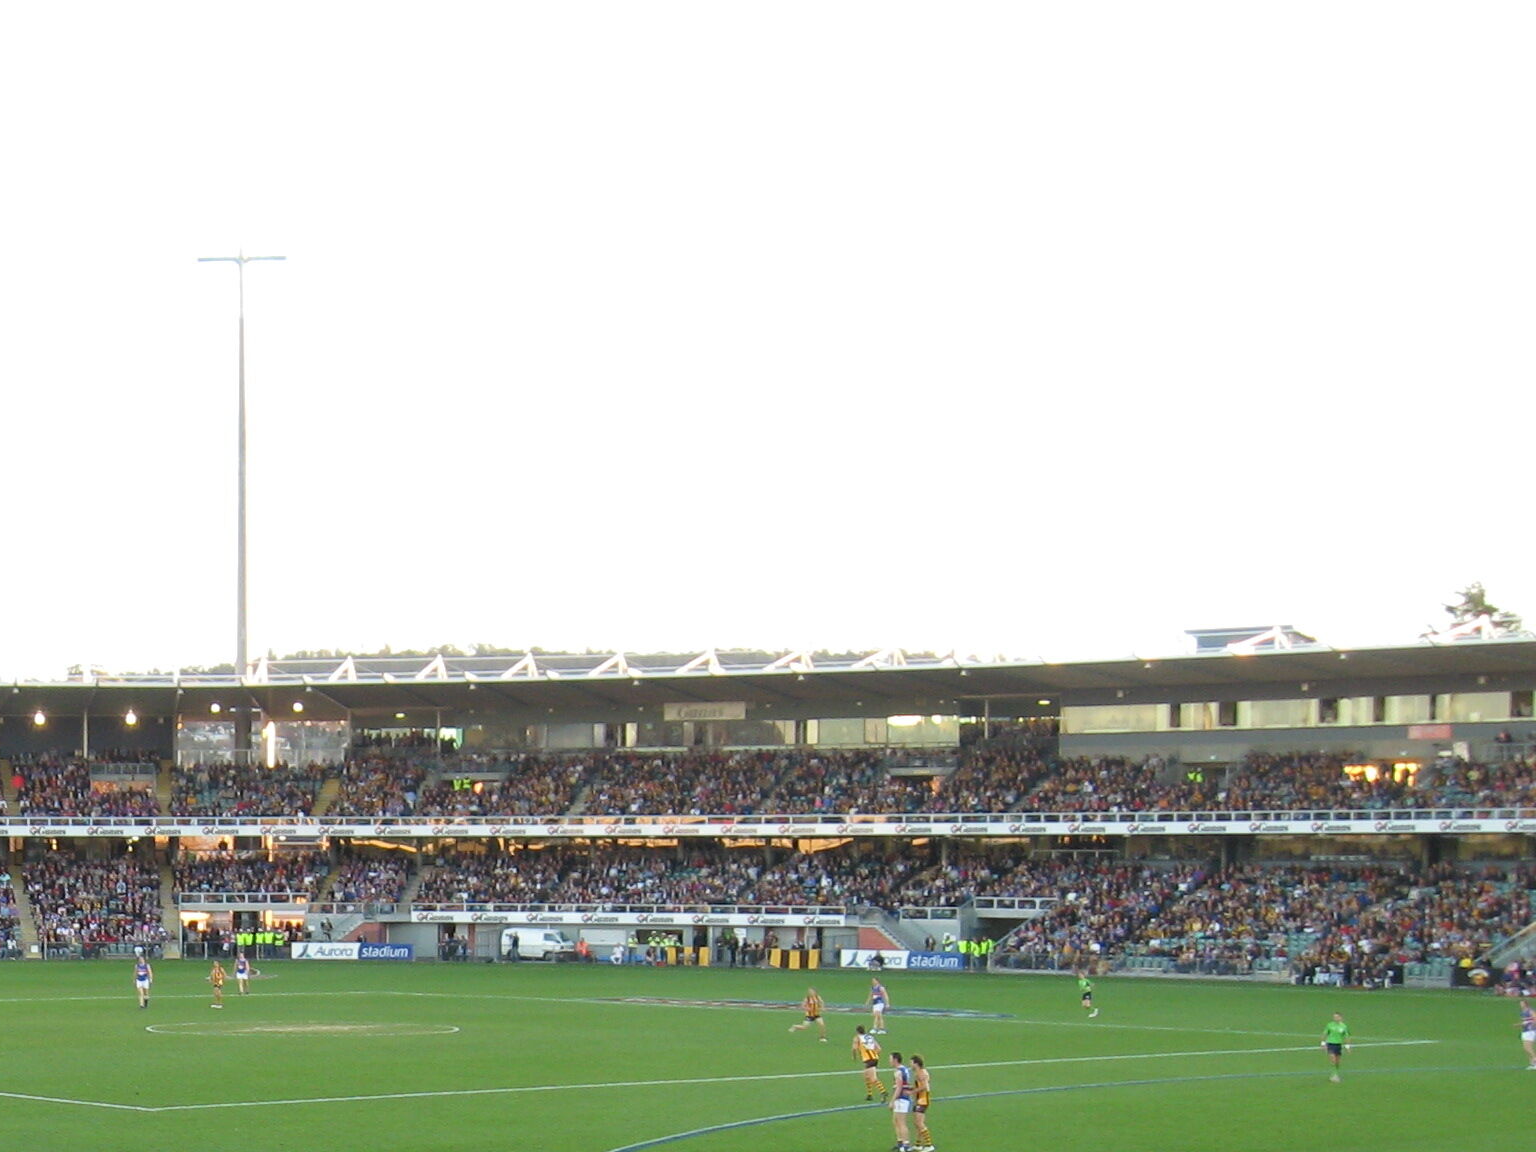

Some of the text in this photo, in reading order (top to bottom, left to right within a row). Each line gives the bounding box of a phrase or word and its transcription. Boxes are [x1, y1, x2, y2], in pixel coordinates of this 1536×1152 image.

[315, 945, 409, 958] Aurora stadium
[865, 954, 959, 968] Aora stadium
